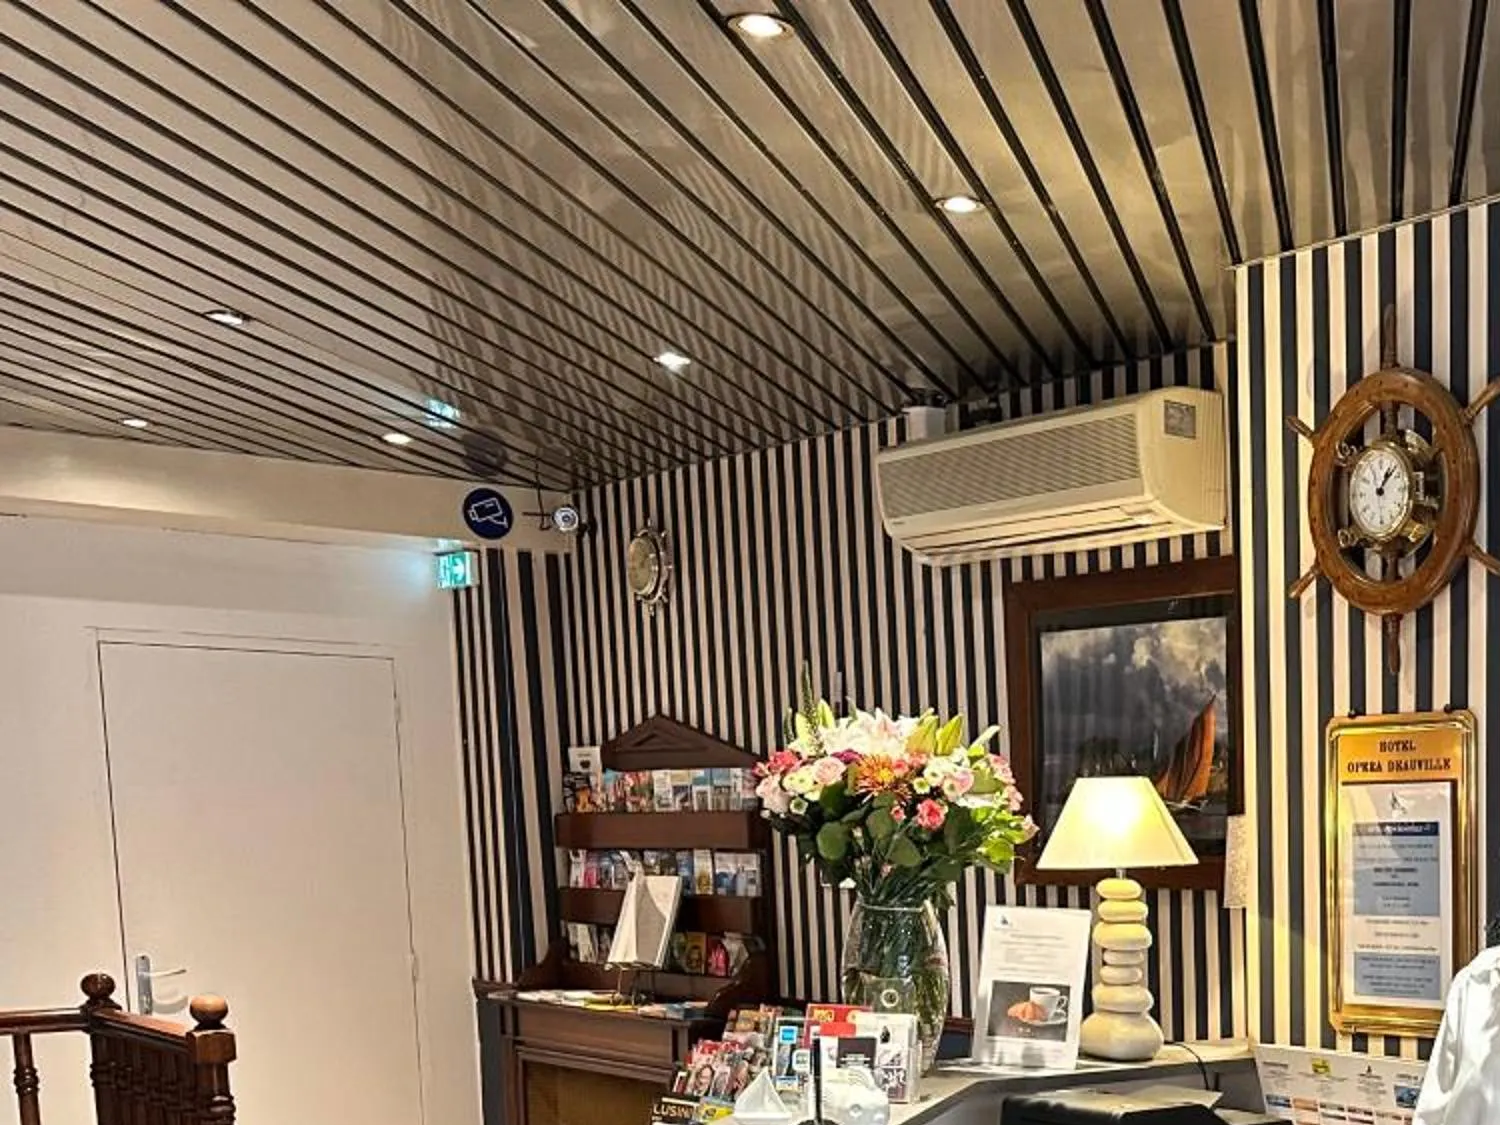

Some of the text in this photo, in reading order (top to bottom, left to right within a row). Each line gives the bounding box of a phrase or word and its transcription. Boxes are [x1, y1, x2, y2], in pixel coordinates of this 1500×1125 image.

[1379, 740, 1417, 753] HOTEL
[1347, 758, 1451, 773] OPERA DEAUVILLE
